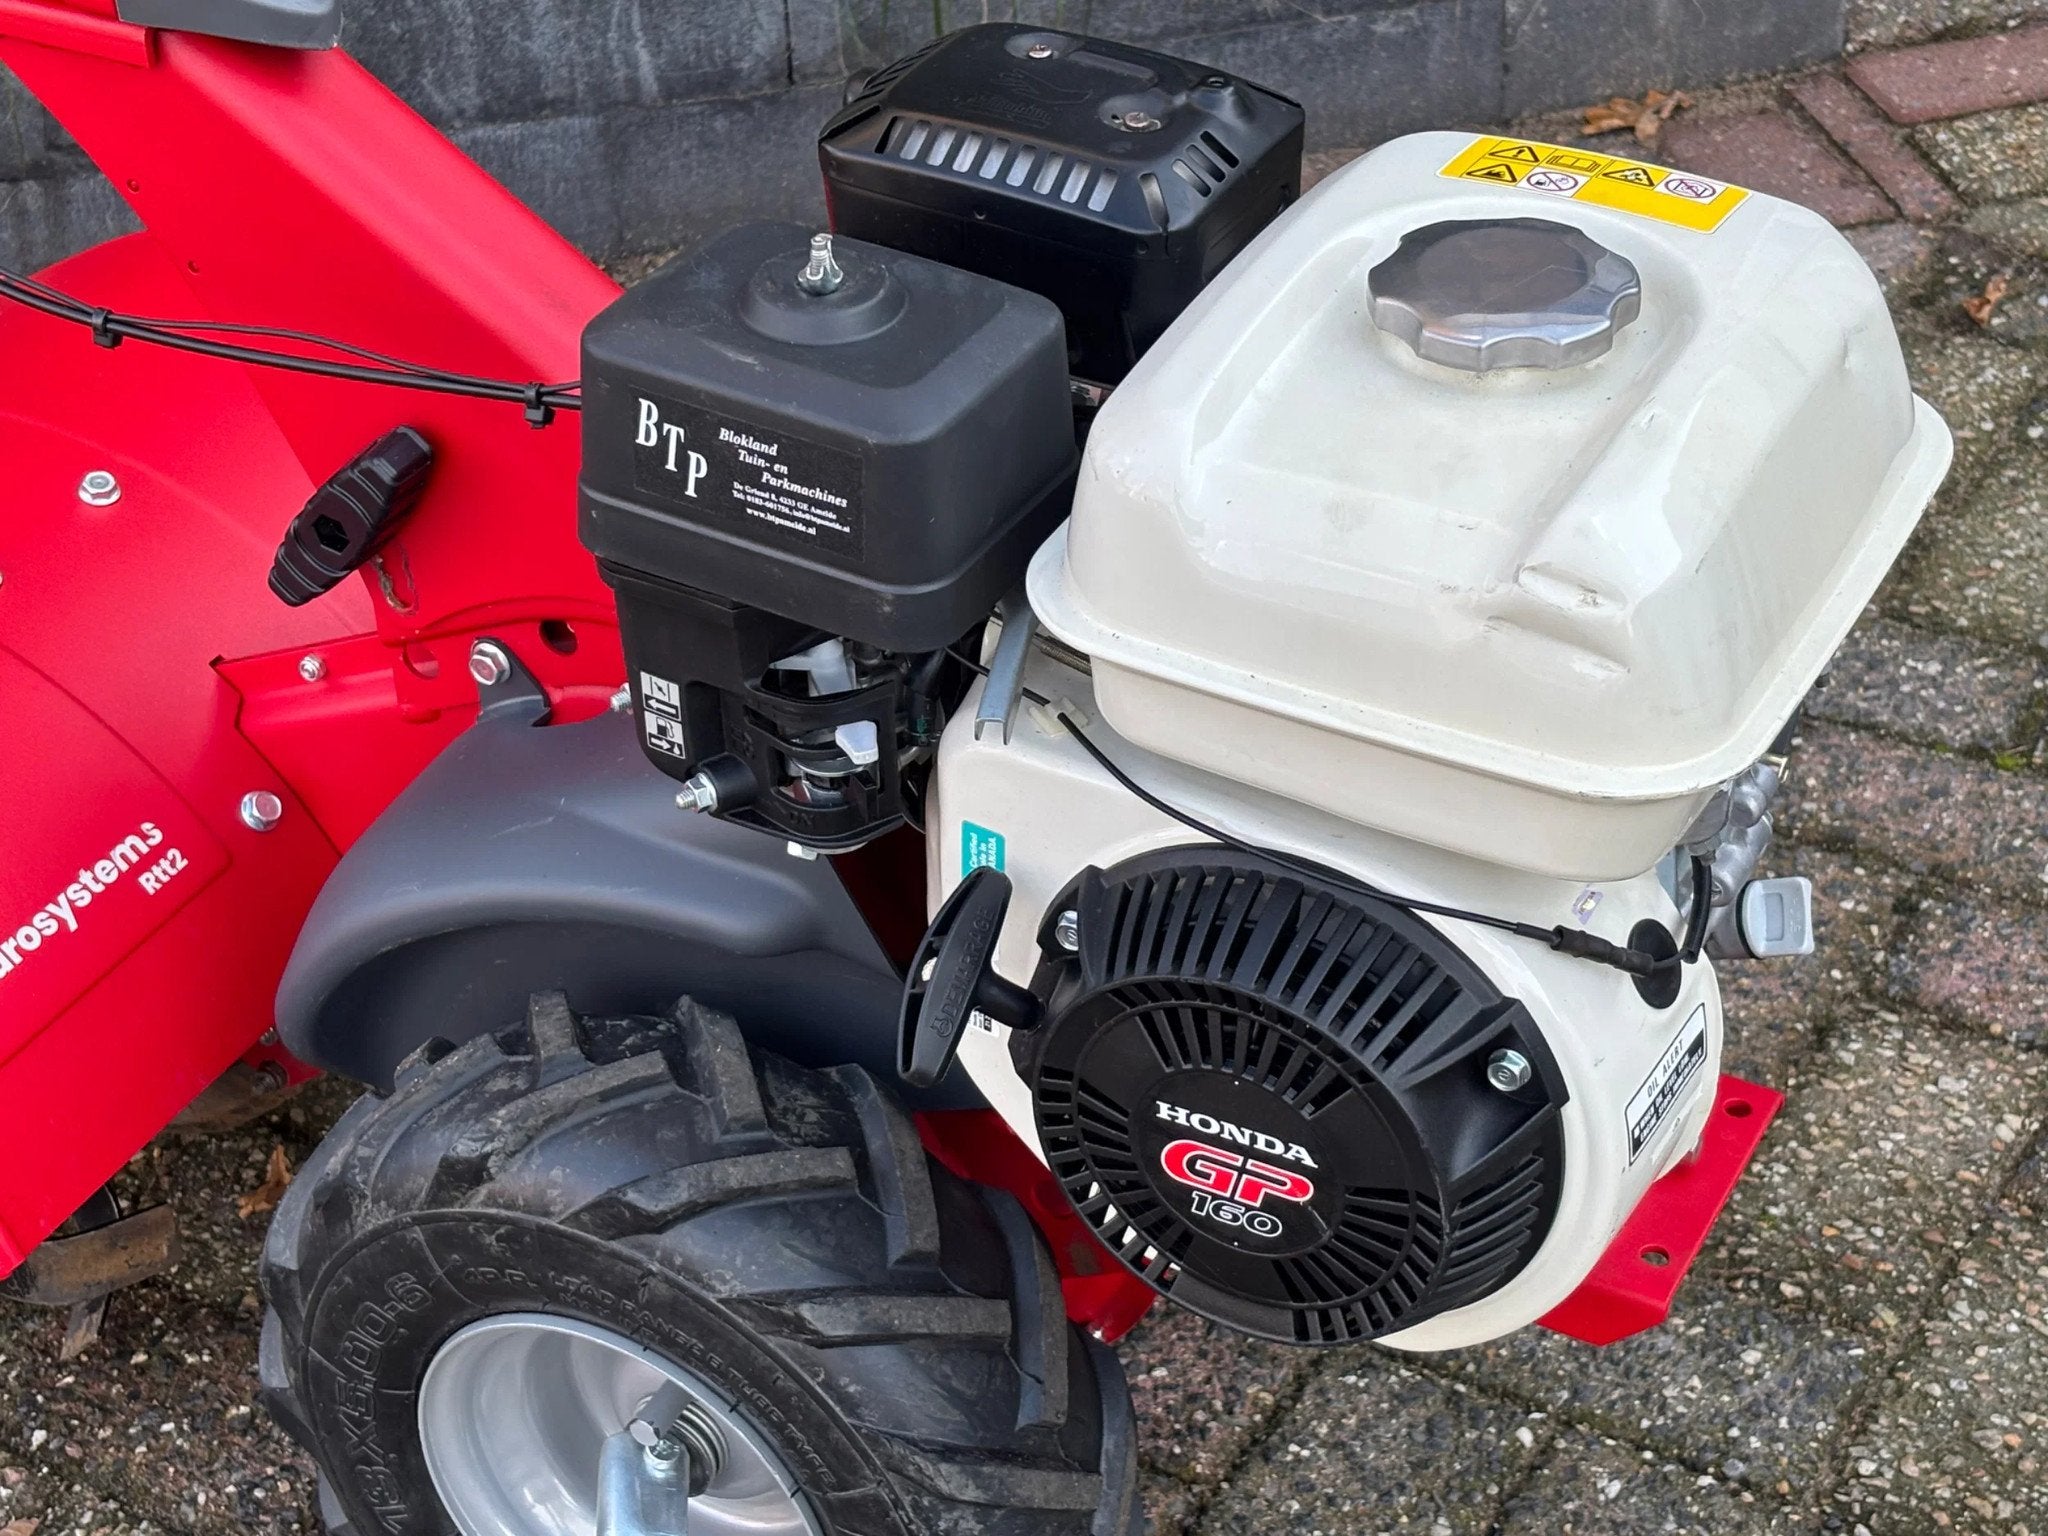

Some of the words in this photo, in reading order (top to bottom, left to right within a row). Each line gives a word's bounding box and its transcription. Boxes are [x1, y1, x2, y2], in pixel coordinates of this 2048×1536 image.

[635, 398, 708, 498] BTP
[719, 428, 778, 456] Blokland
[738, 449, 770, 468] Tuin-
[773, 462, 789, 475] en
[761, 472, 848, 508] Parkmachines
[138, 848, 189, 896] Rtt2
[1647, 1077, 1660, 1098] OIL
[1662, 1039, 1684, 1077] ALERT
[1156, 1100, 1319, 1169] HONDA
[1160, 1139, 1314, 1208] GP
[1191, 1190, 1283, 1238] 160
